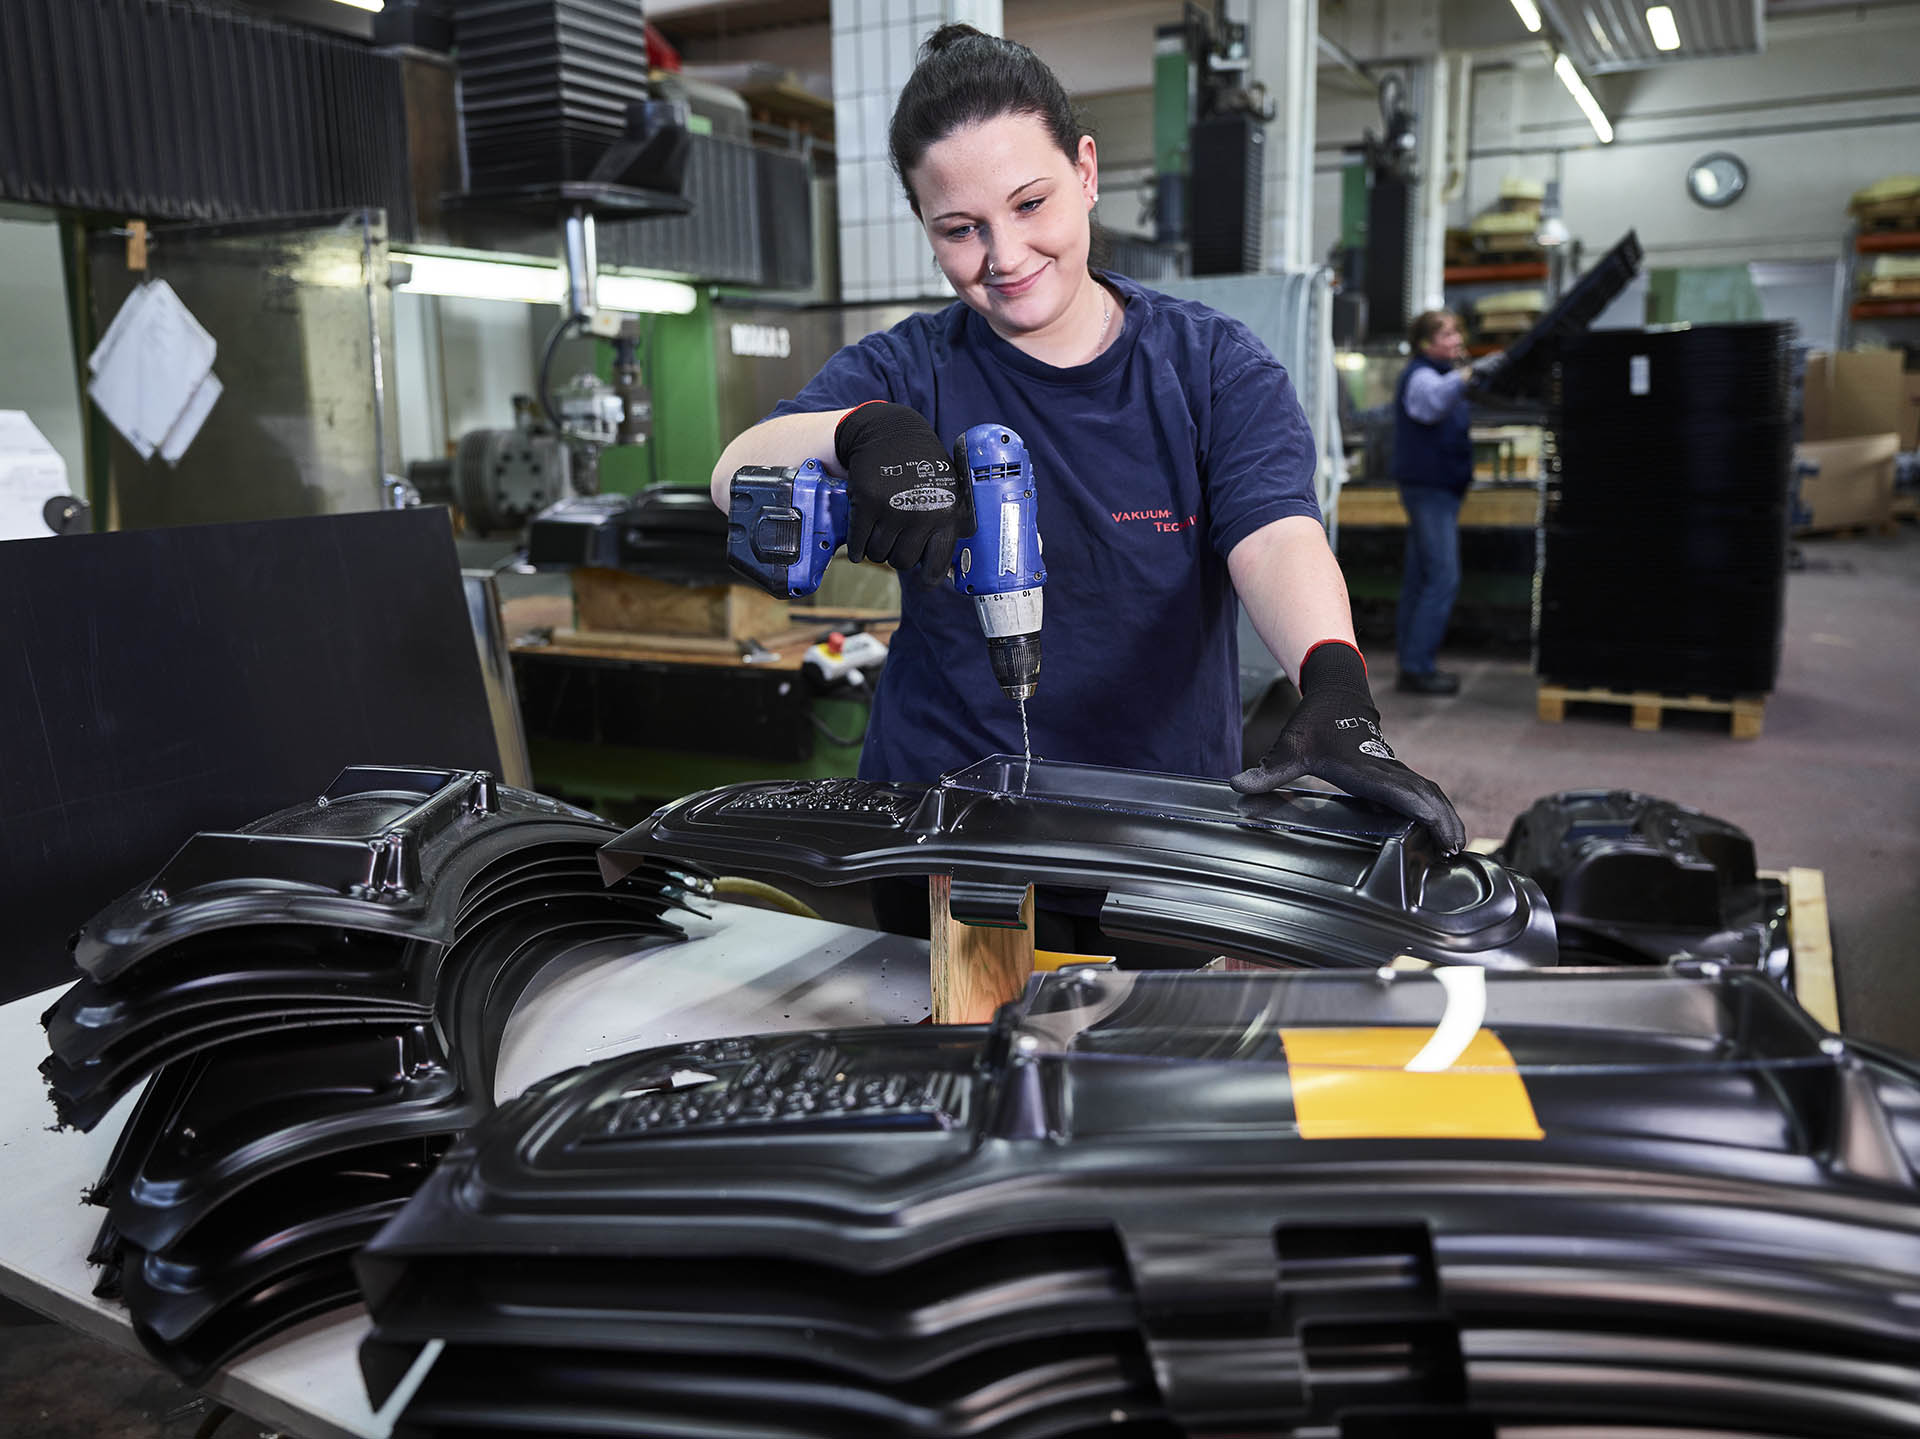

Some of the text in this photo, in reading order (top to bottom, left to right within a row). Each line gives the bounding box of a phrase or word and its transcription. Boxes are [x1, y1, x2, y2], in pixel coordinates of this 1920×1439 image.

[892, 494, 953, 506] STRONG
[1111, 509, 1172, 523] VAKUUM-
[993, 594, 1004, 602] 13
